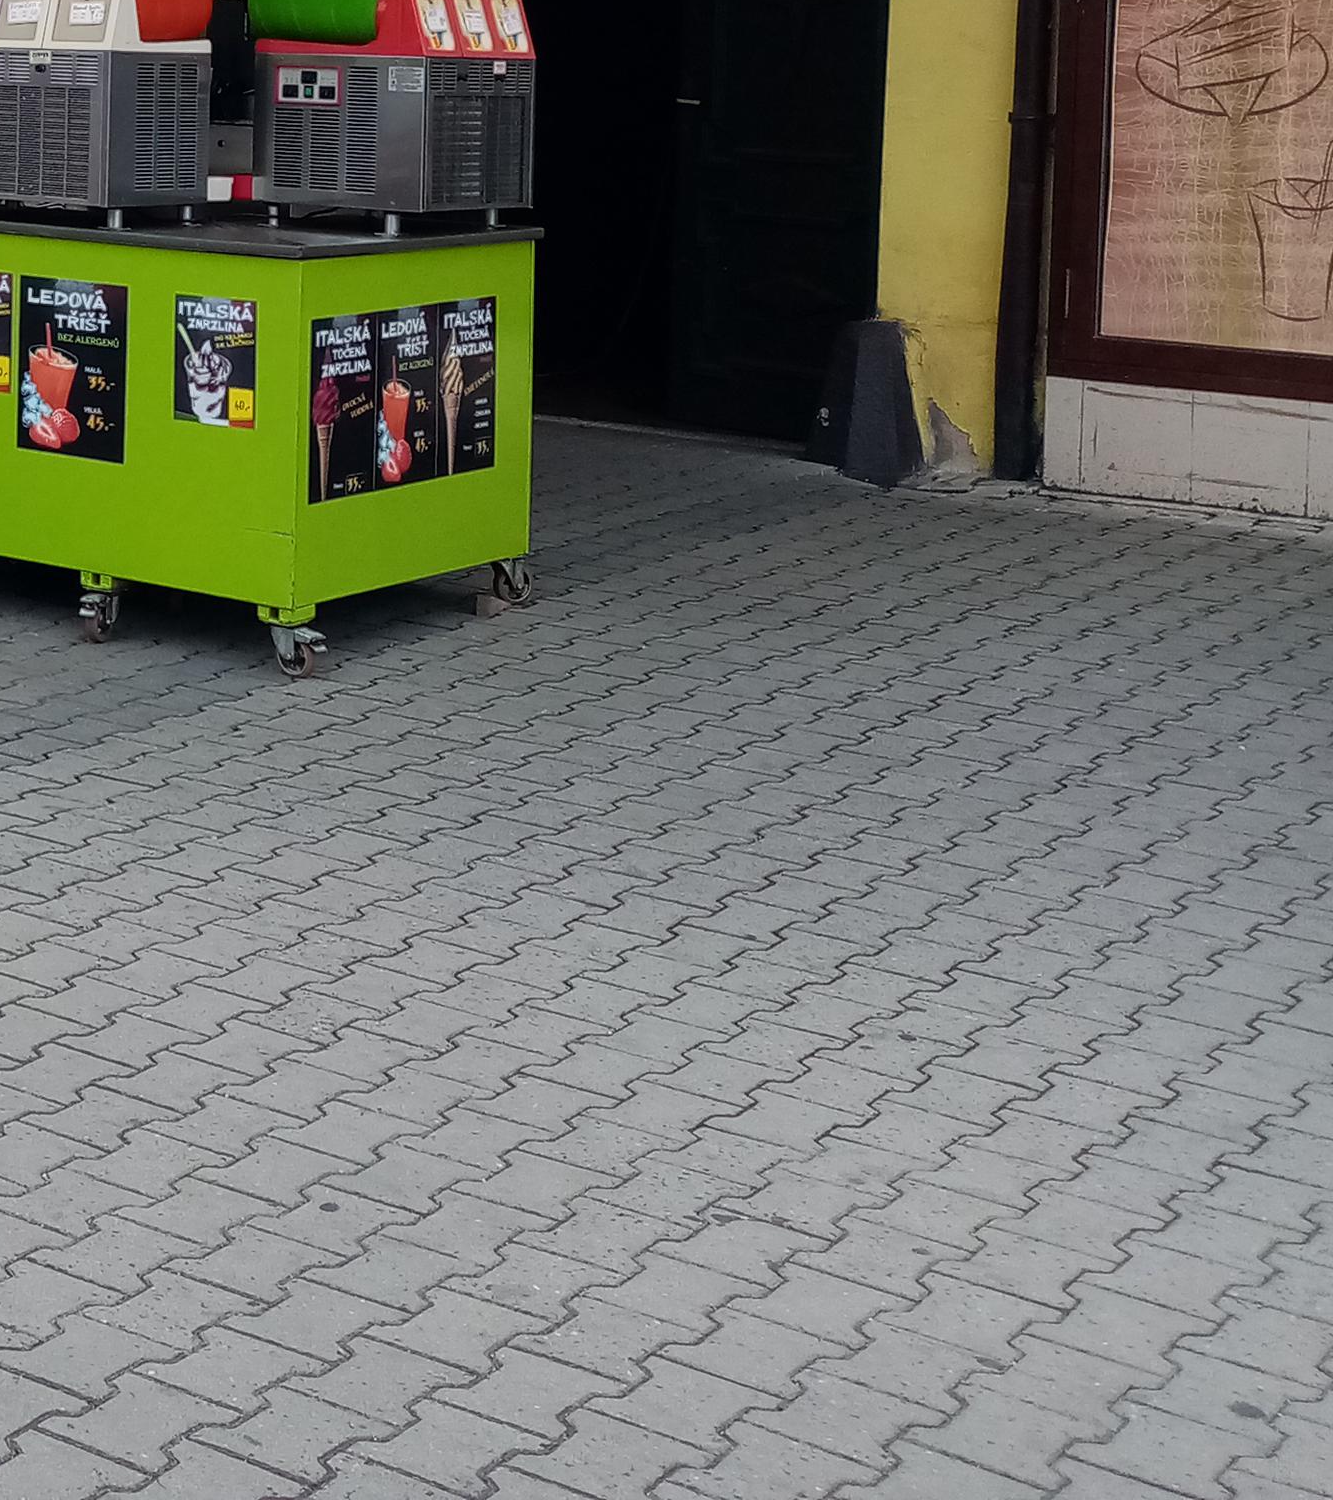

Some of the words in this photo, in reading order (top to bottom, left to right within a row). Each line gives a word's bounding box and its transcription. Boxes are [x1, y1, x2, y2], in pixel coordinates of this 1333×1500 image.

[27, 287, 108, 312] LEDOVÁ
[54, 310, 111, 334] TŘÍŠŤ
[178, 301, 253, 322] ITALSKÁ
[444, 302, 493, 330] ITALSKÁ
[187, 318, 244, 333] ZMRZLINA
[315, 318, 371, 348] ITALSKÁ
[381, 311, 427, 339] LEDOVÁ
[459, 325, 490, 342] TOČENÁ
[57, 332, 74, 343] BEZ
[75, 334, 120, 349] ALERGENŮ
[450, 341, 494, 358] ZMRZLINA
[332, 342, 367, 361] TOČENÁ
[321, 357, 372, 379] ZMRZLINA
